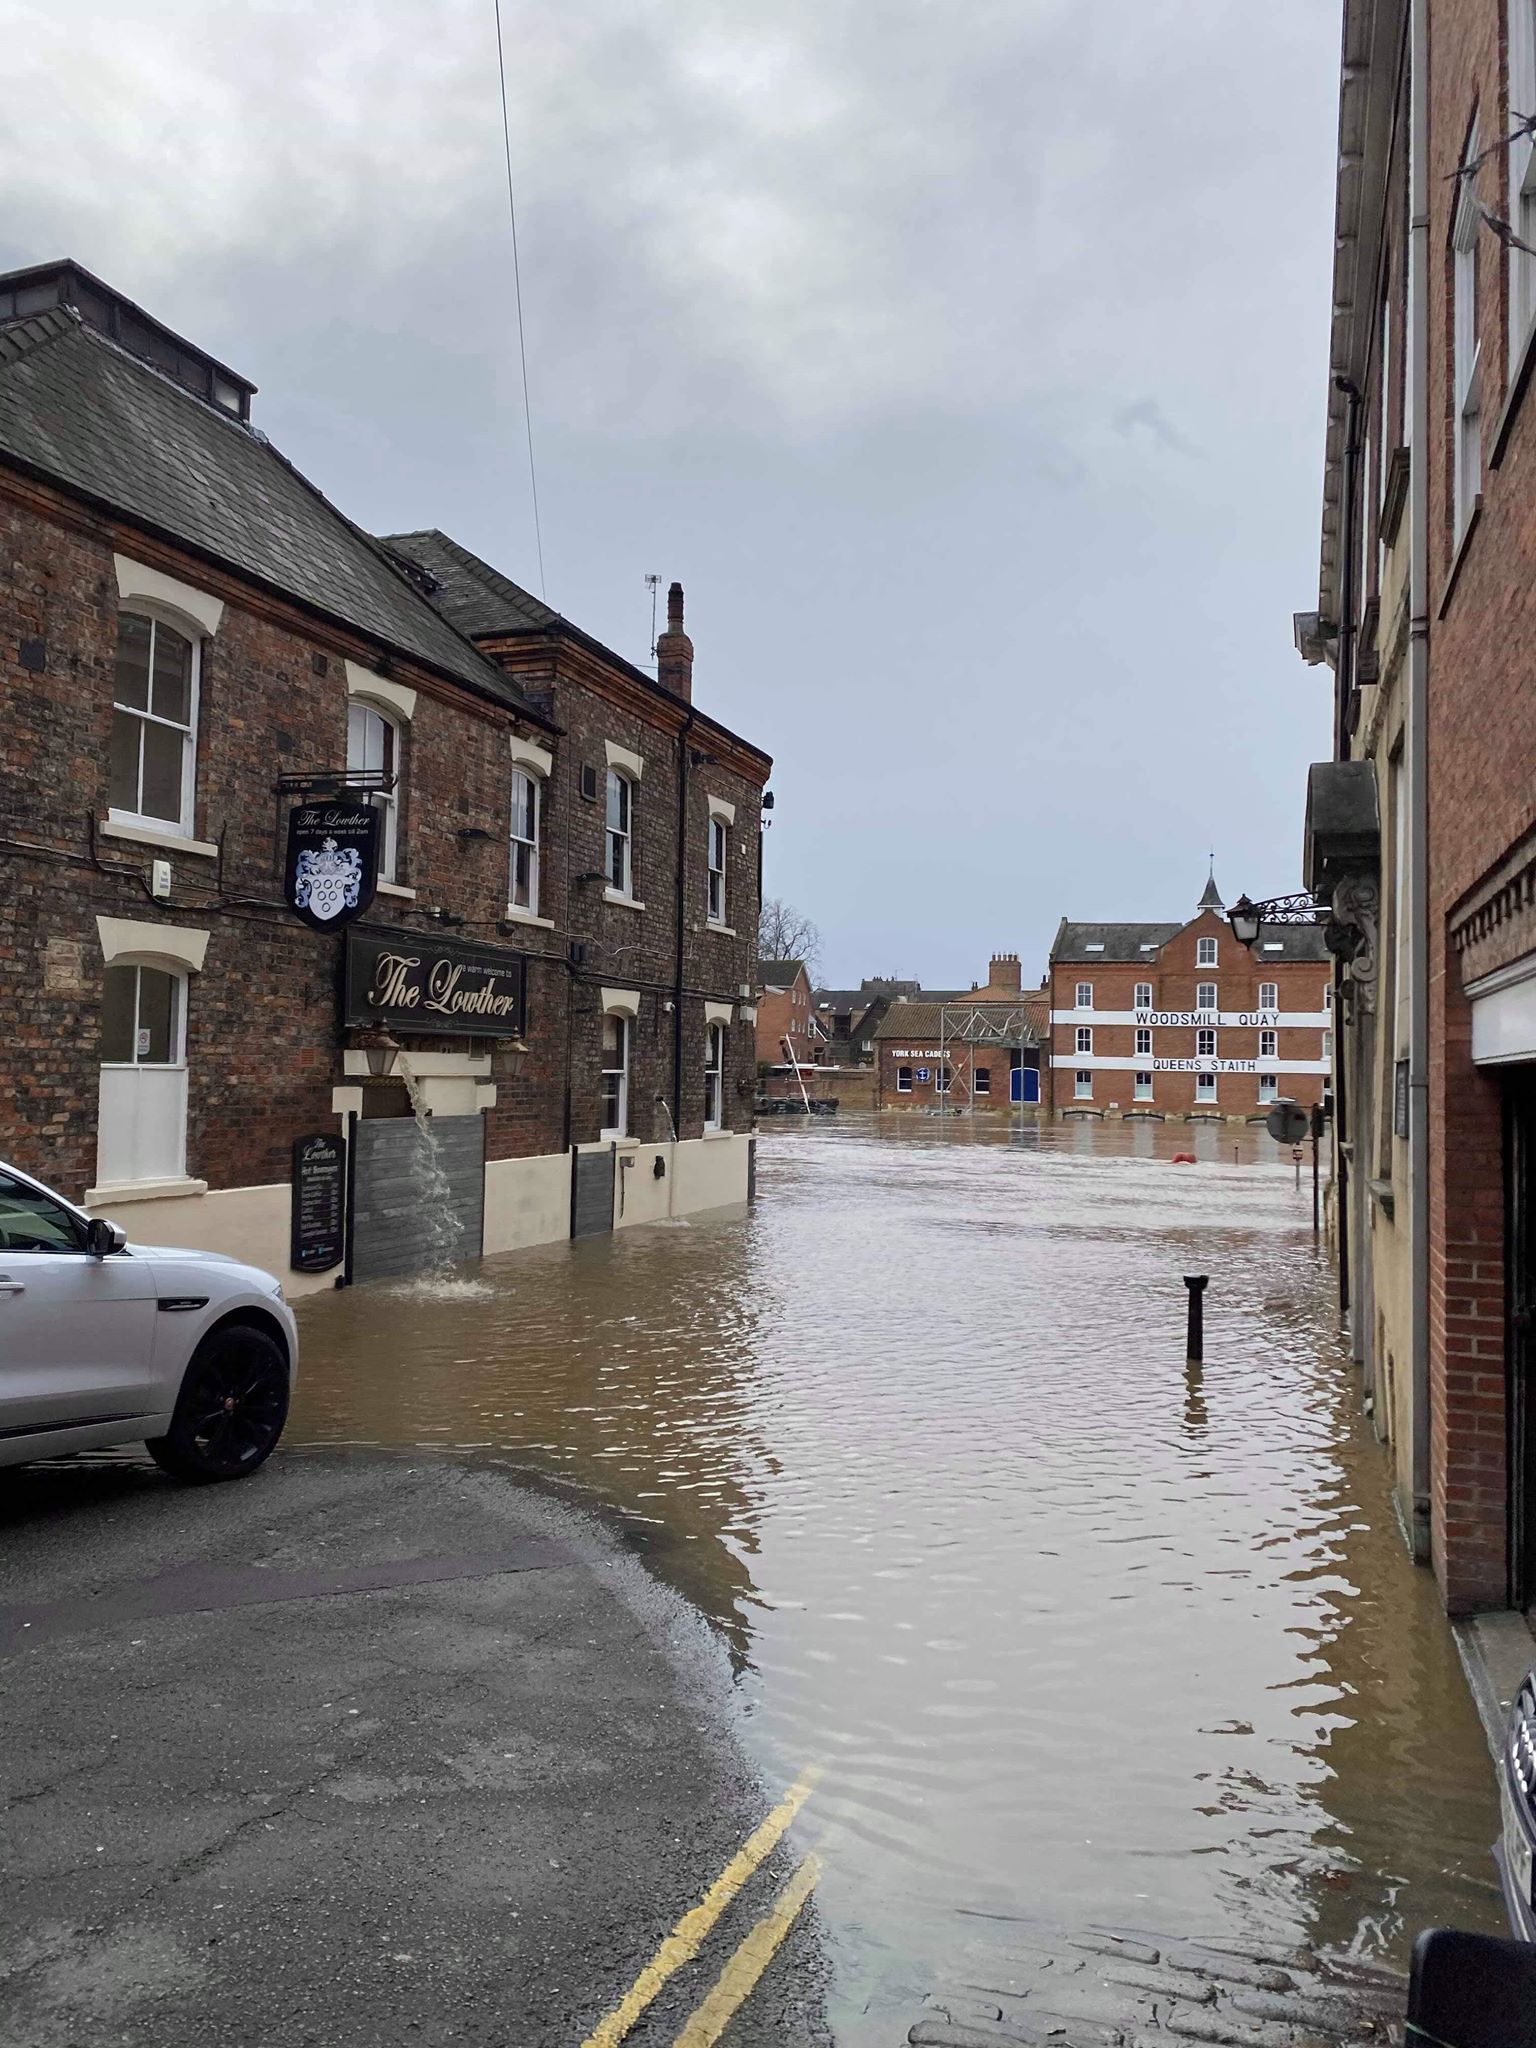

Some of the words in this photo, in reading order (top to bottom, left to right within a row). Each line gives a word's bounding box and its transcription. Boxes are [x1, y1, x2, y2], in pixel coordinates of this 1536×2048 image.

[297, 809, 320, 826] The
[322, 809, 370, 827] Lowther
[467, 965, 482, 974] warm
[483, 967, 506, 977] welcome
[506, 969, 512, 978] to
[367, 951, 421, 1008] The
[423, 959, 514, 1016] Lowther
[1136, 1013, 1227, 1025] WOODSMILL
[1239, 1014, 1279, 1025] QUAY
[910, 1050, 924, 1058] SEA
[1153, 1059, 1202, 1071] QUEENS
[1211, 1060, 1256, 1072] STAITH
